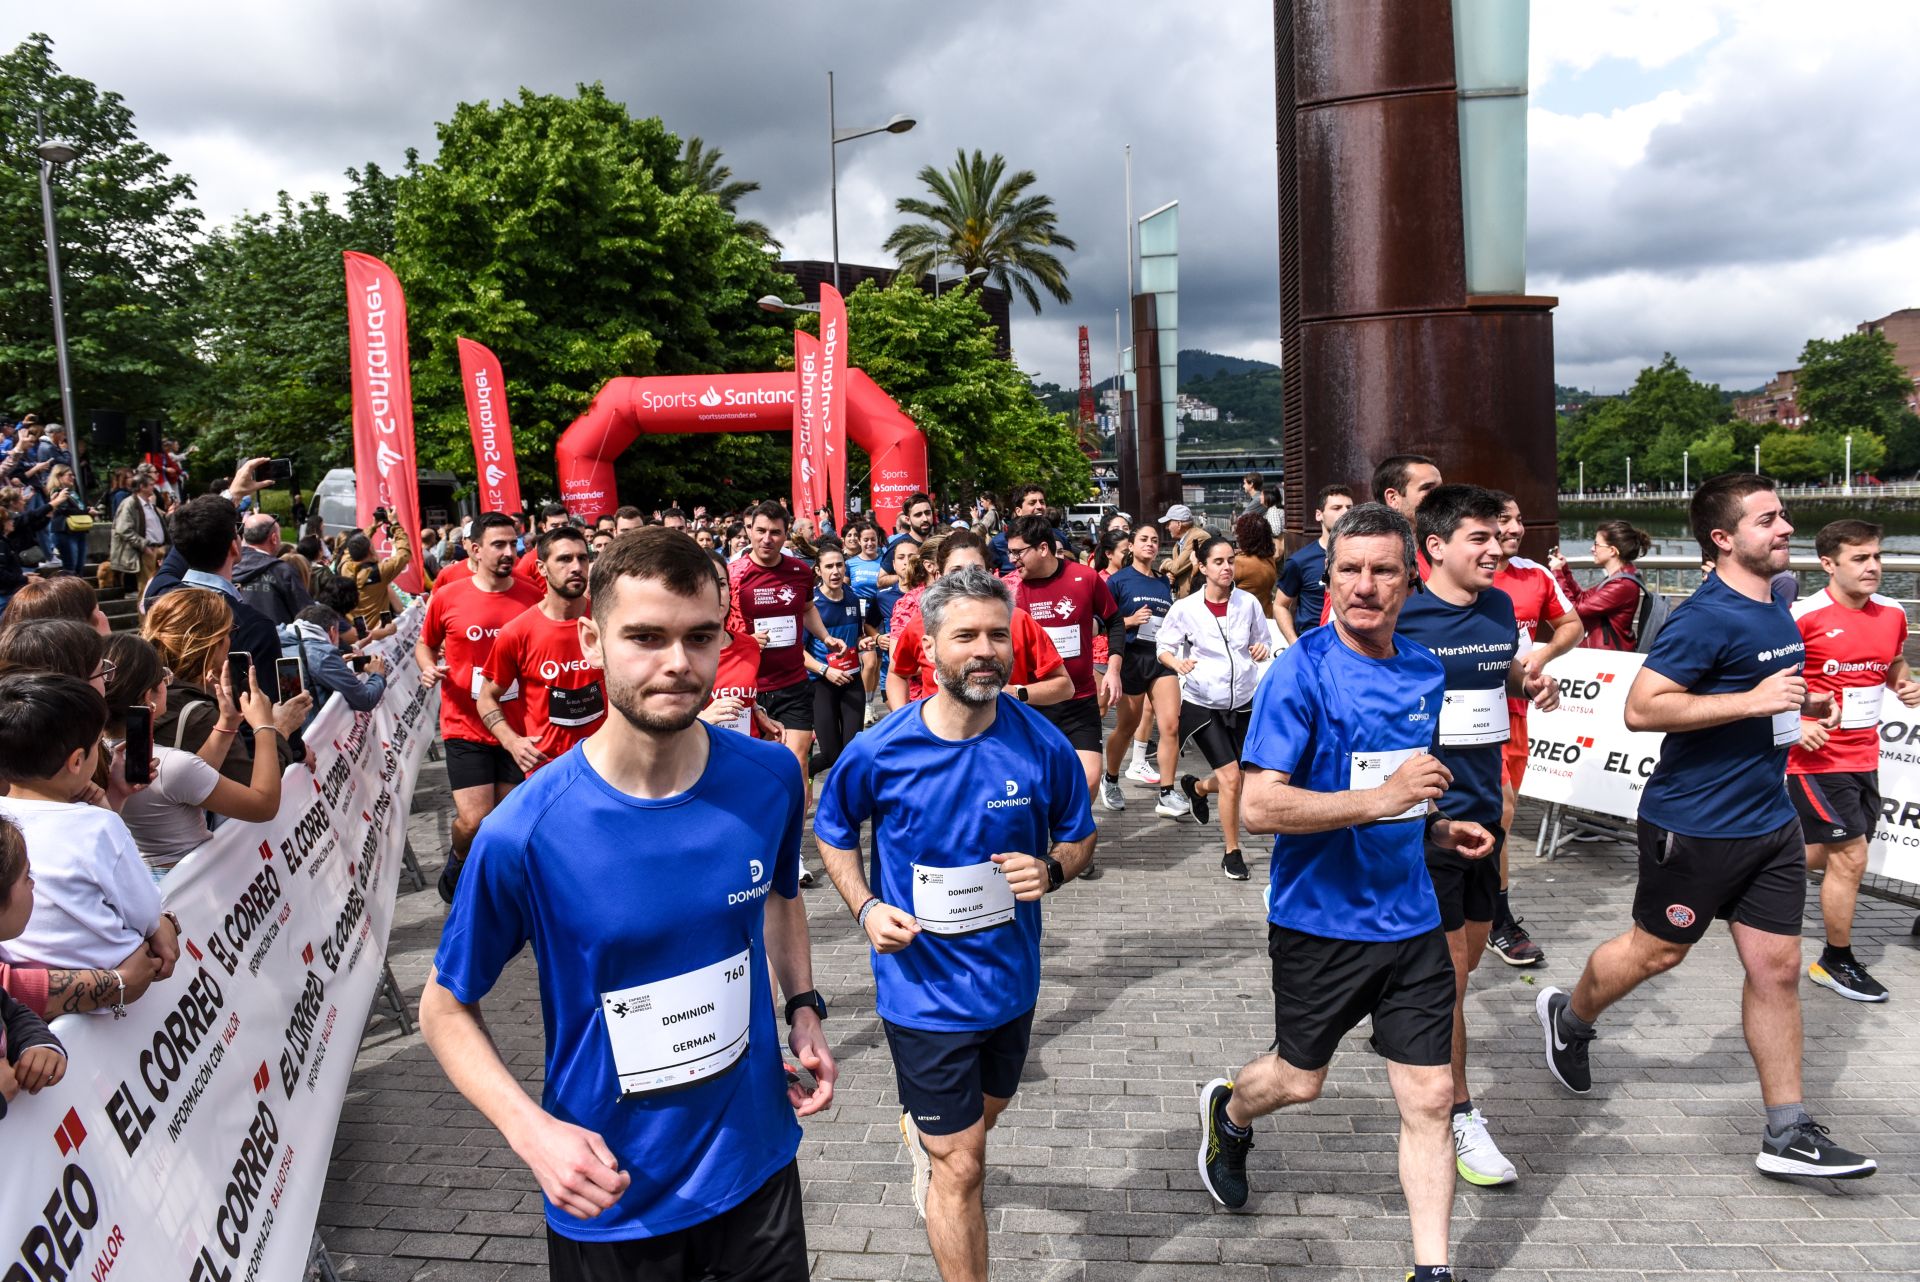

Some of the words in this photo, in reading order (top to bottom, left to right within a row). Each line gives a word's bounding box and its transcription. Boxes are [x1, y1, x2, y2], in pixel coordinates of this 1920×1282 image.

[641, 391, 697, 412] Sports
[565, 479, 591, 489] Sports
[881, 470, 909, 480] Sports
[565, 491, 604, 501] Santander
[880, 483, 920, 492] Santander
[1437, 643, 1512, 657] MarshMcLennan
[560, 660, 600, 673] VEO
[711, 687, 758, 700] VEOLIA
[1554, 678, 1601, 700] REO
[1556, 702, 1594, 715] ALIOTSUA
[1532, 764, 1548, 773] CON
[1549, 767, 1574, 779] VALOR
[1604, 751, 1632, 775] EL
[280, 838, 302, 876] EL
[728, 880, 772, 906] DOMINIO
[948, 886, 983, 897] DOMINION
[207, 932, 238, 977] EL
[225, 863, 281, 953] CORREO
[949, 907, 968, 915] JUAN
[969, 904, 984, 912] LUIS
[321, 935, 341, 974] EL
[724, 965, 745, 983] 760
[286, 969, 324, 1066] CORREO
[662, 1002, 715, 1026] DOMINION
[673, 1033, 716, 1053] GERMAN
[105, 1080, 157, 1158] EL
[139, 965, 224, 1103] CORREO
[167, 1063, 214, 1144] INFORMACIÓN
[209, 1040, 226, 1069] CON
[221, 1011, 241, 1046] VALOR
[279, 1046, 300, 1101] EL
[216, 1100, 279, 1260] CORREO
[270, 1143, 295, 1209] BALIOTSUA
[91, 1224, 125, 1282] VALOR
